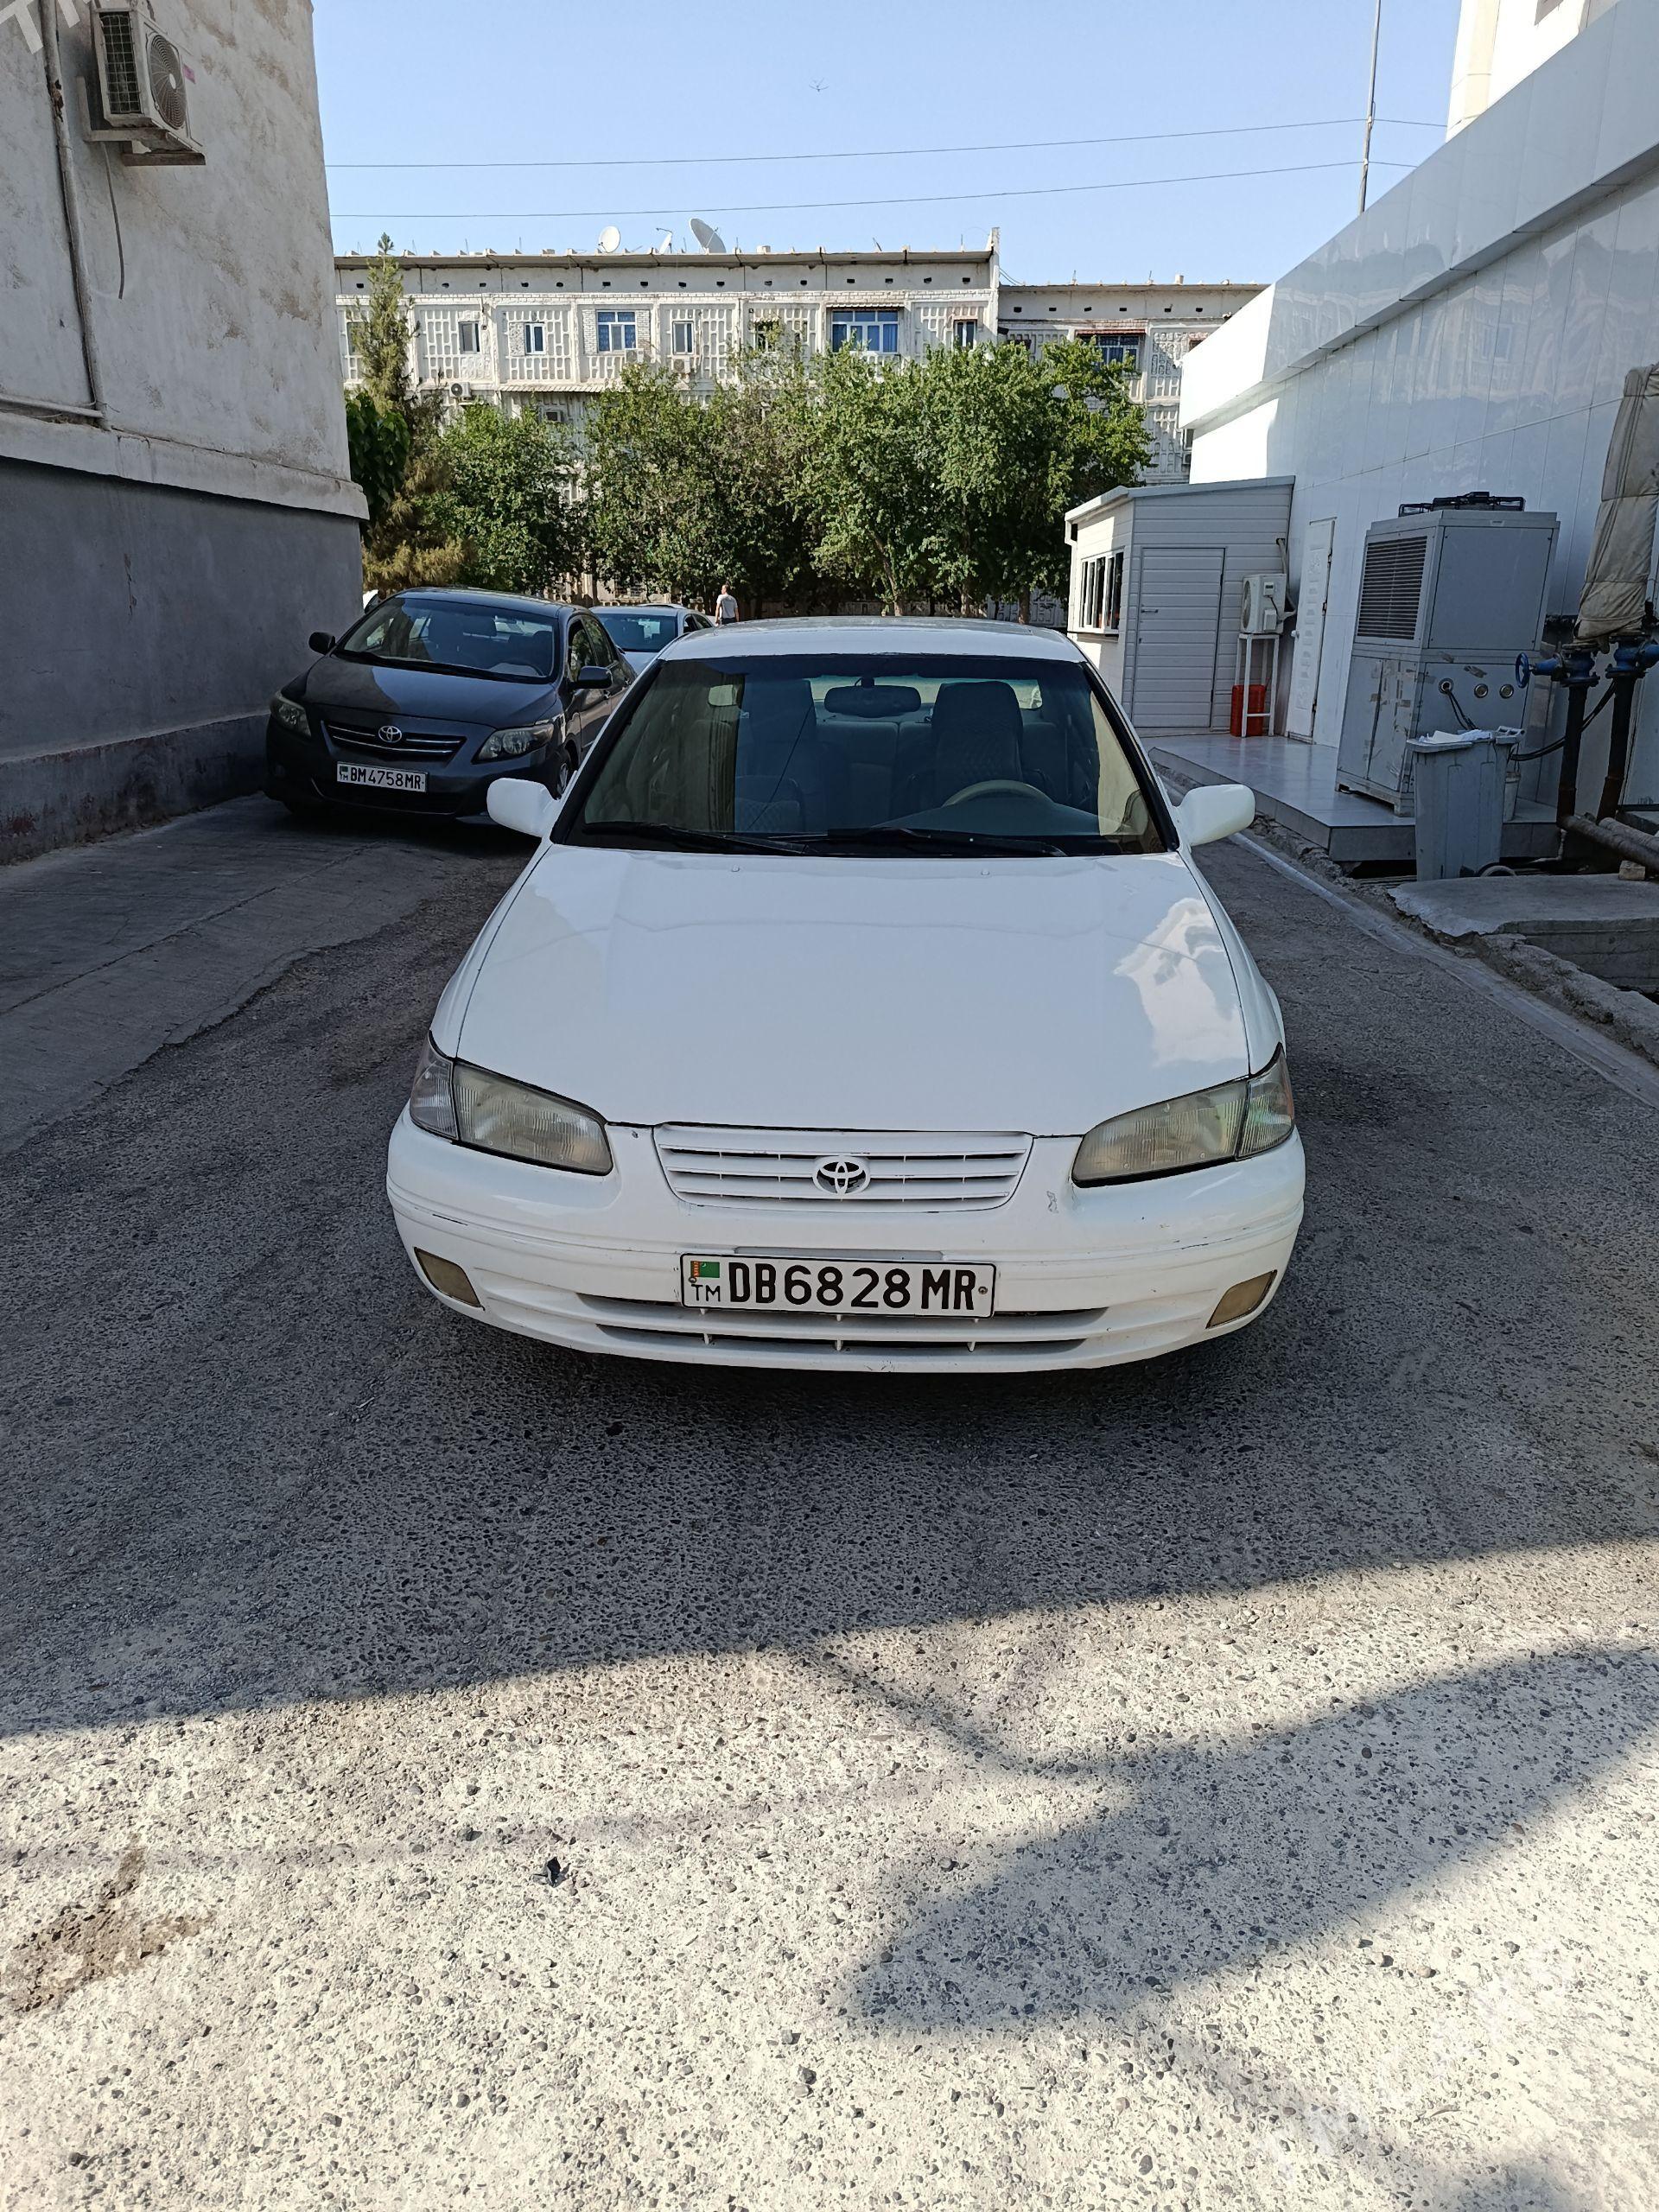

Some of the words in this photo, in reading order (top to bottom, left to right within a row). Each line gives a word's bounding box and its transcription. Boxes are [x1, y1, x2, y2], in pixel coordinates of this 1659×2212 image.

[350, 767, 421, 790] BM4758MR
[691, 1283, 721, 1302] TM
[728, 1262, 977, 1311] DB6828MR
